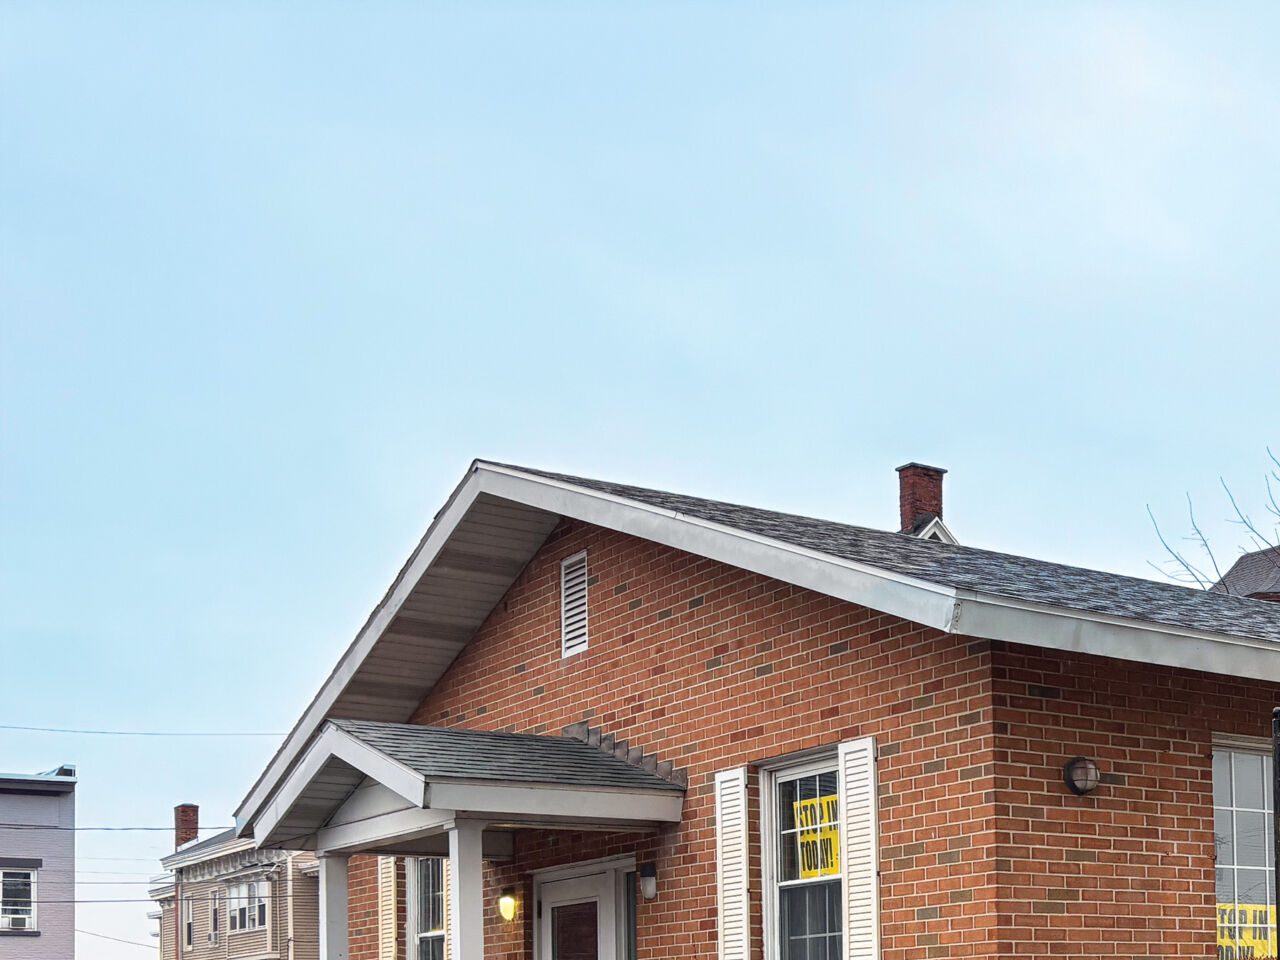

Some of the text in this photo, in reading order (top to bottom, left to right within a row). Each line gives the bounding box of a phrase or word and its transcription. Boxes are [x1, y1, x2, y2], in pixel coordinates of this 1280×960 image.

[796, 800, 838, 836] STOP IN
[800, 838, 833, 871] TODAY!
[1218, 908, 1268, 940] TOP IN
